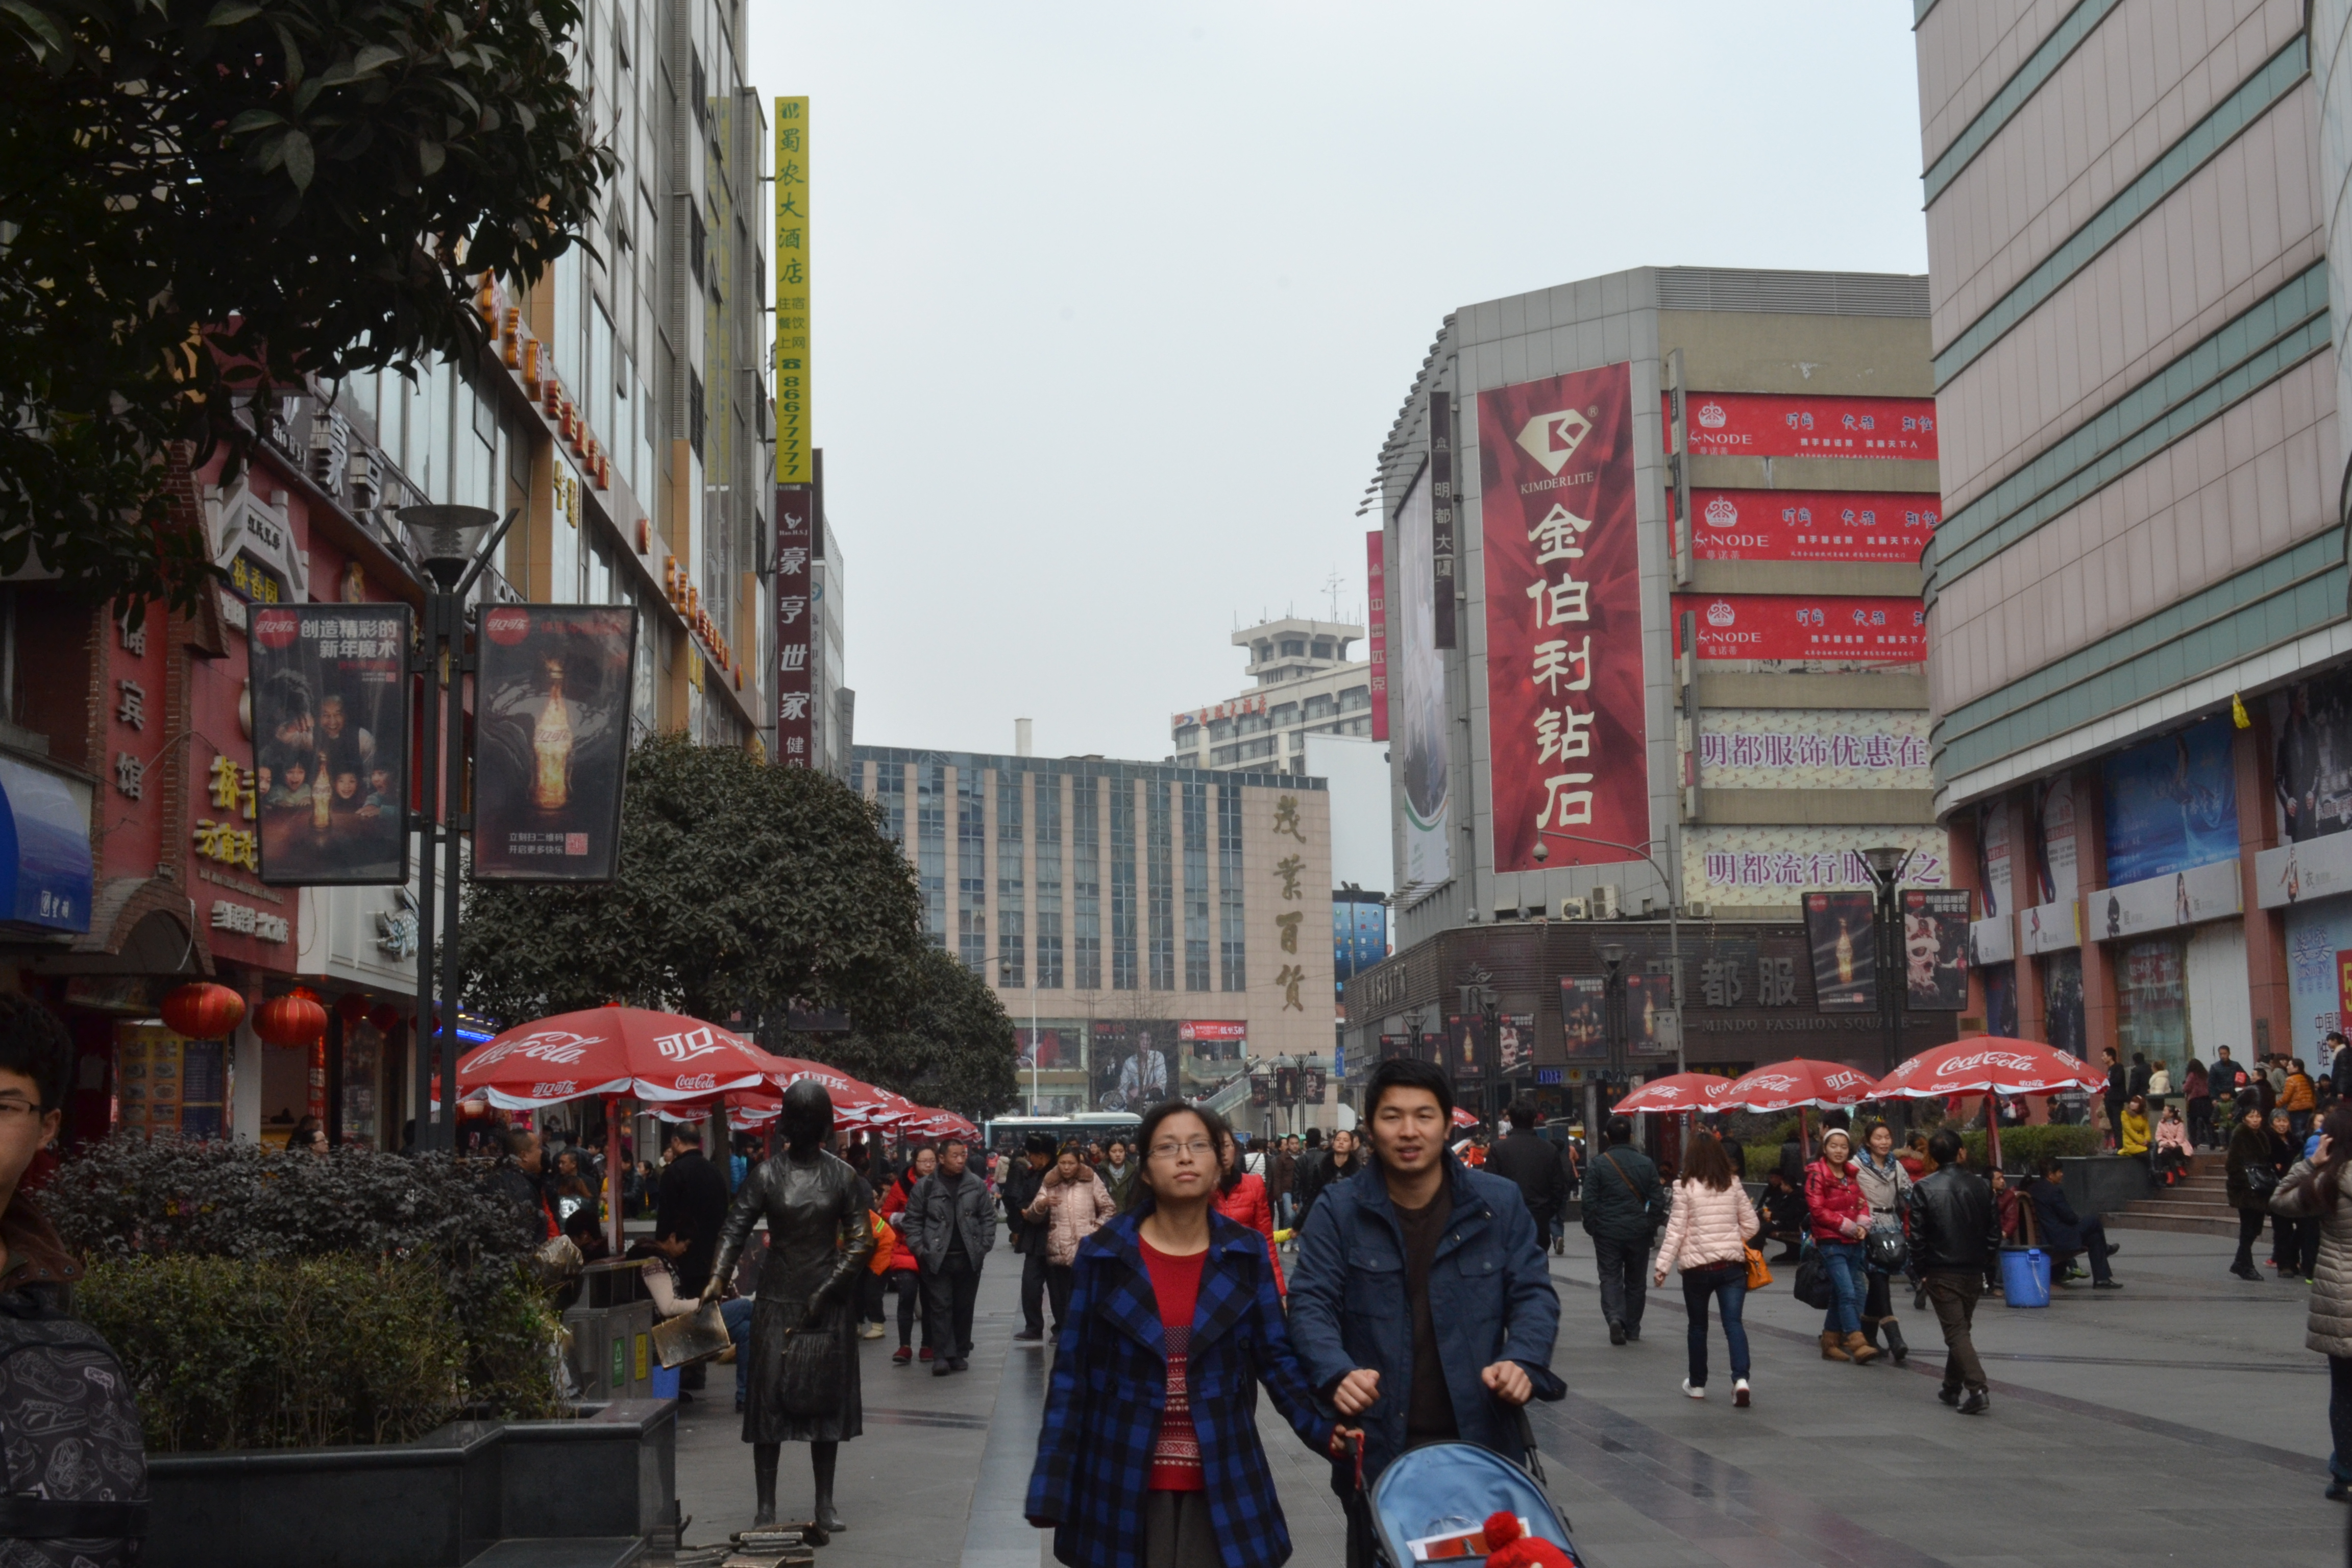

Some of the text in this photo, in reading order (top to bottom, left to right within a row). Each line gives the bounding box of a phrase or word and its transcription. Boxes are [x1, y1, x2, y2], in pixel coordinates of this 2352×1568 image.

[775, 128, 805, 284] 蜀农大酒店
[778, 297, 805, 309] 住宿
[778, 316, 805, 330] 餐饮
[778, 336, 805, 350] 上网
[783, 376, 800, 476] 86677777
[1704, 434, 1752, 445] NODE
[1521, 472, 1595, 495] KIMDERLITE
[1434, 482, 1452, 577] 明都大厦
[1710, 534, 1769, 547] NODE
[256, 620, 296, 634] 可口可乐
[300, 619, 398, 639] 创造精彩的
[487, 618, 528, 631] 可口可乐
[779, 547, 811, 720] 豪亨世家
[1711, 632, 1762, 644] NODE
[319, 640, 397, 658] 新年魔术
[1370, 598, 1386, 691] 中国匹克
[1527, 503, 1595, 829] 金伯利钻石
[1699, 734, 1928, 767] 明都服饰优惠在
[509, 832, 564, 843] 立刻扫二维码
[1707, 852, 1943, 885] 明都流行服之
[1702, 1019, 1758, 1032] MINDO
[1766, 1017, 1838, 1031] FASHION
[1936, 1049, 2038, 1076] Coca-Cola
[532, 1080, 578, 1097] 可口可乐
[675, 1073, 717, 1089] Coca-Cola
